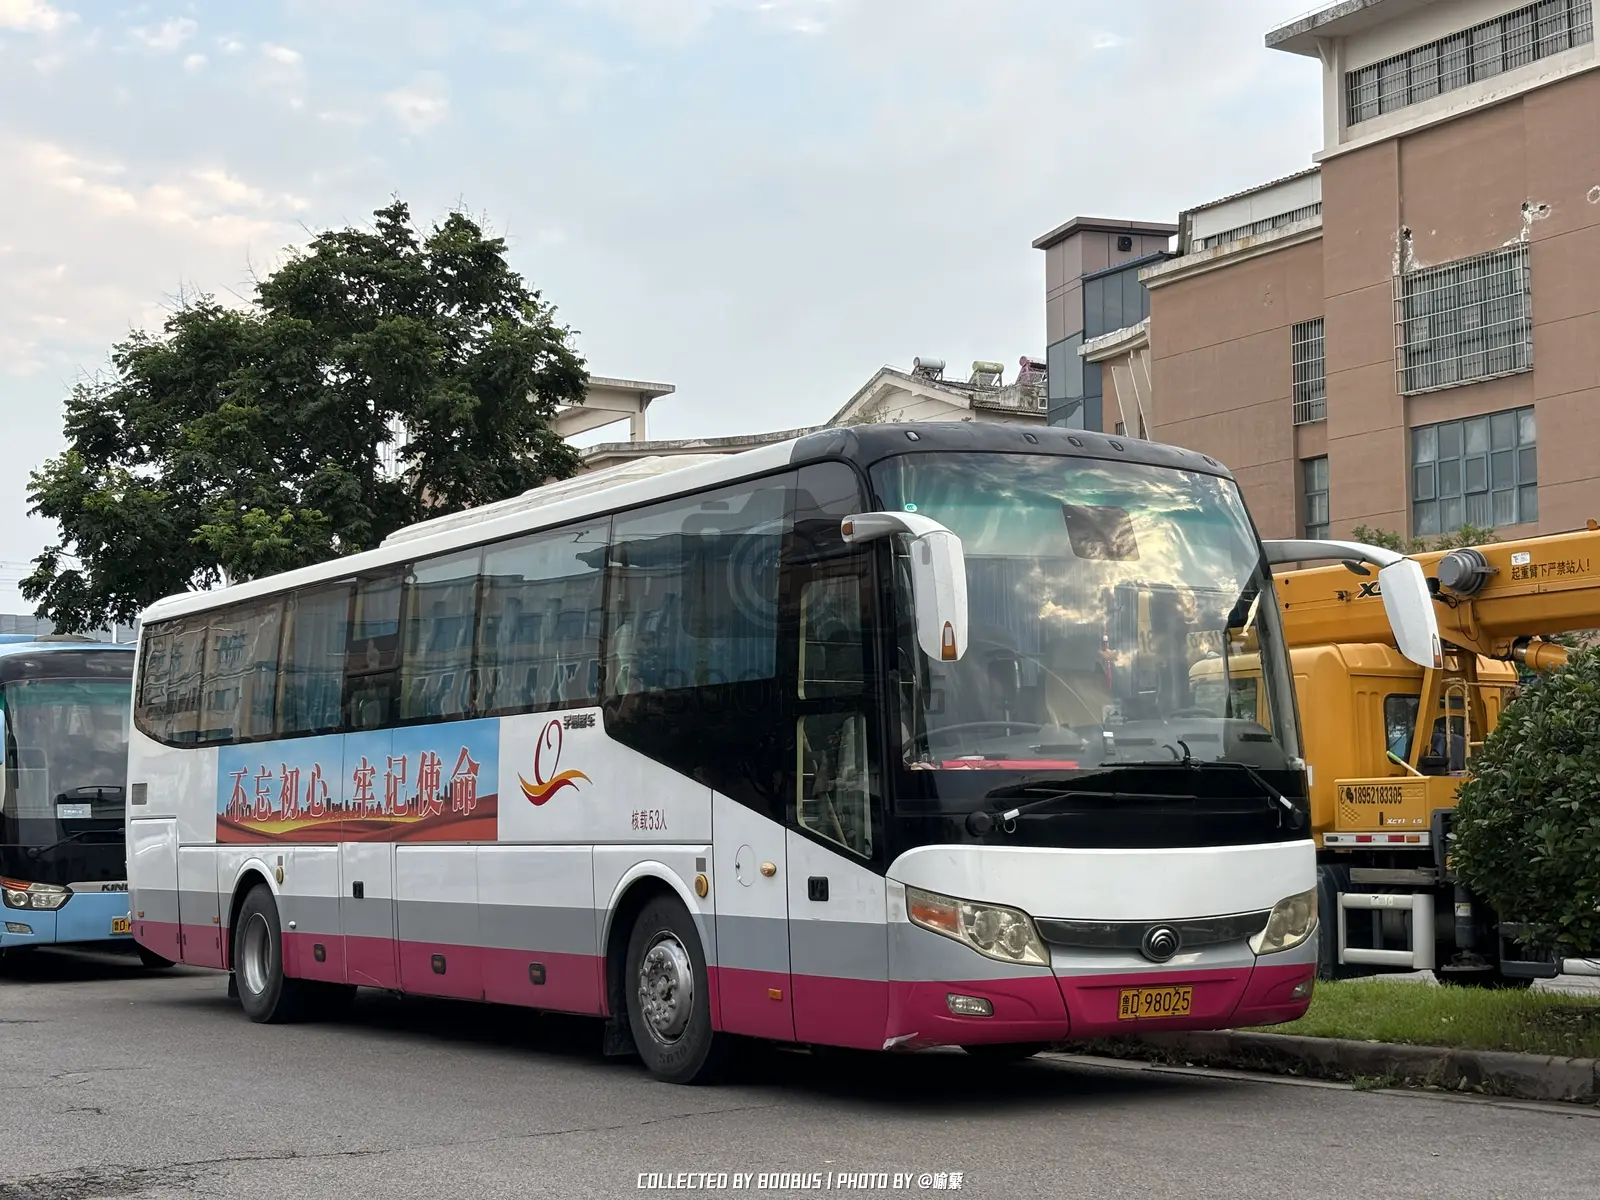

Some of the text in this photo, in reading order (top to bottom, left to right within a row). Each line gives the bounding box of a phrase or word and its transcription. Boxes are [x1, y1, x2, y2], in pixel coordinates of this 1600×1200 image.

[228, 746, 481, 822] 不忘初心 牢记使命
[1354, 786, 1402, 804] 18952183305
[631, 809, 667, 830] 核载53人
